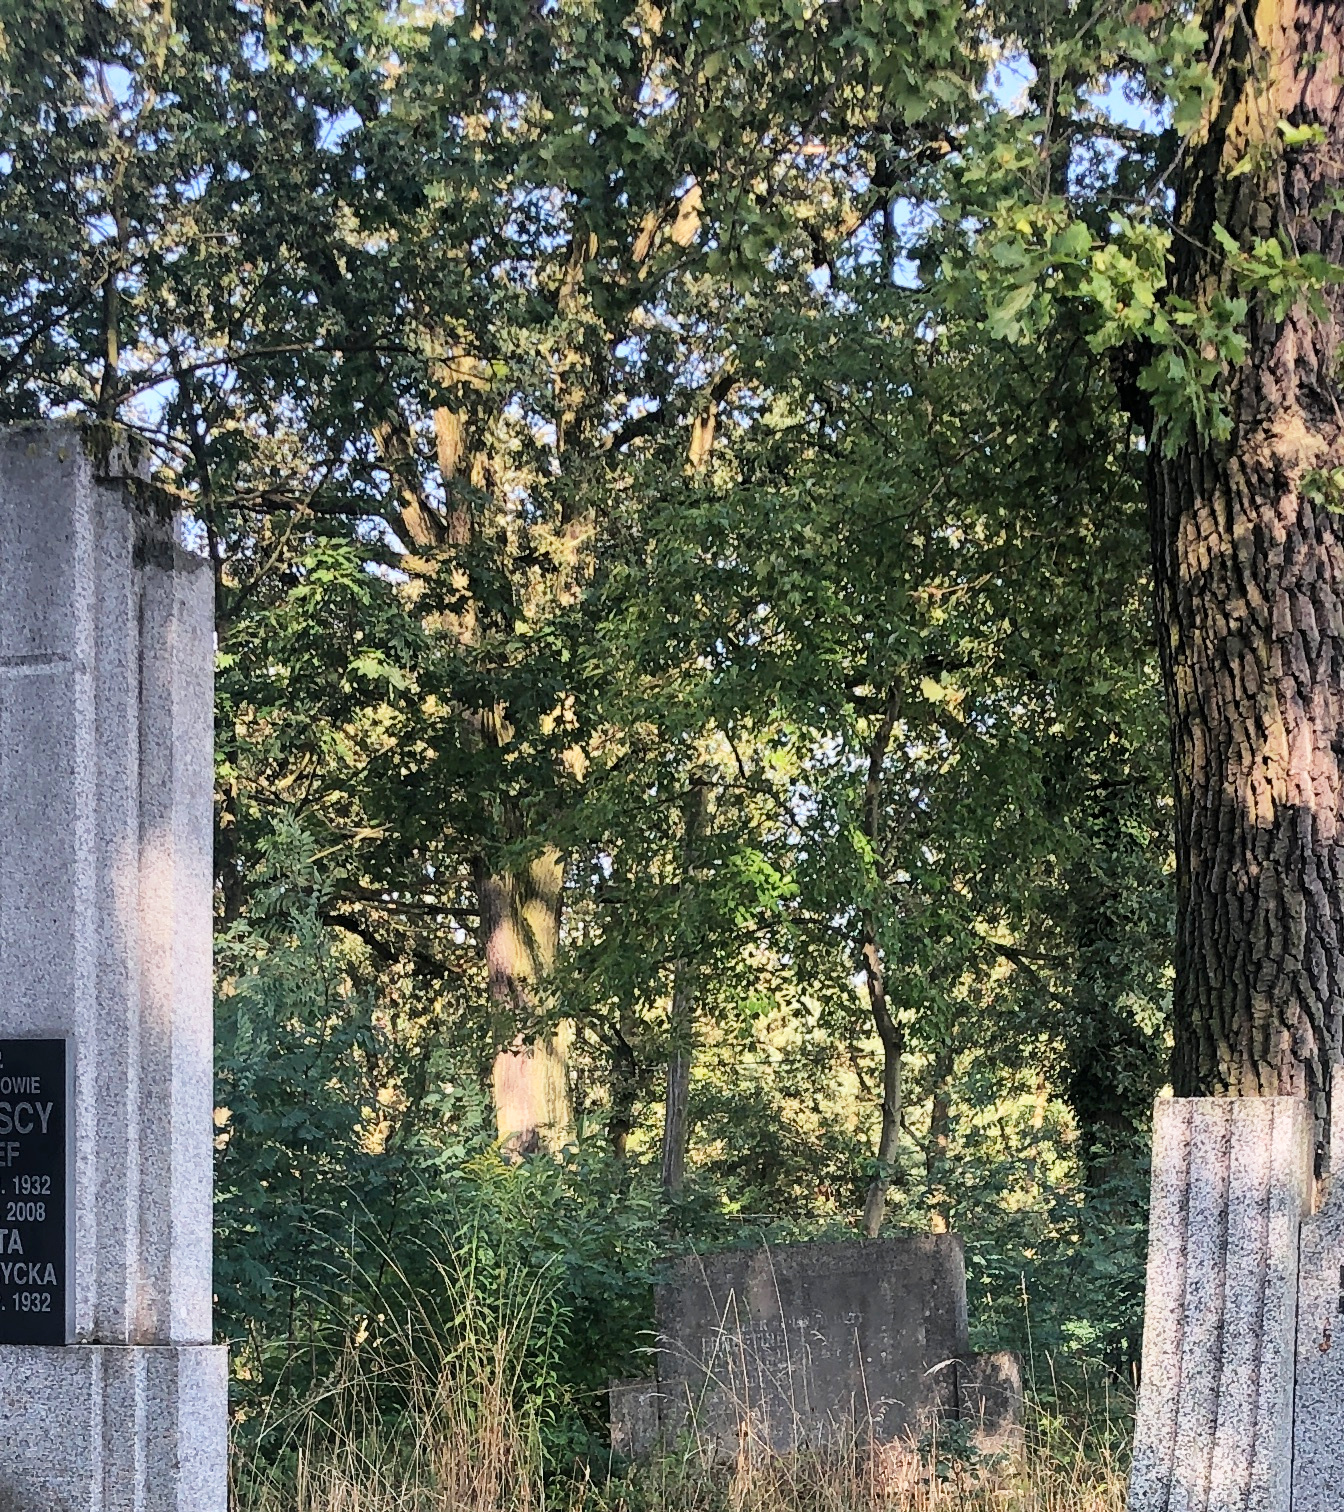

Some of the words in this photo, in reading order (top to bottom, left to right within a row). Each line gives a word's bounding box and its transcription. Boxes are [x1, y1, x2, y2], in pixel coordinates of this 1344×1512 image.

[12, 1175, 51, 1195] 1932
[6, 1202, 46, 1221] 2008
[12, 1292, 51, 1312] 1932
